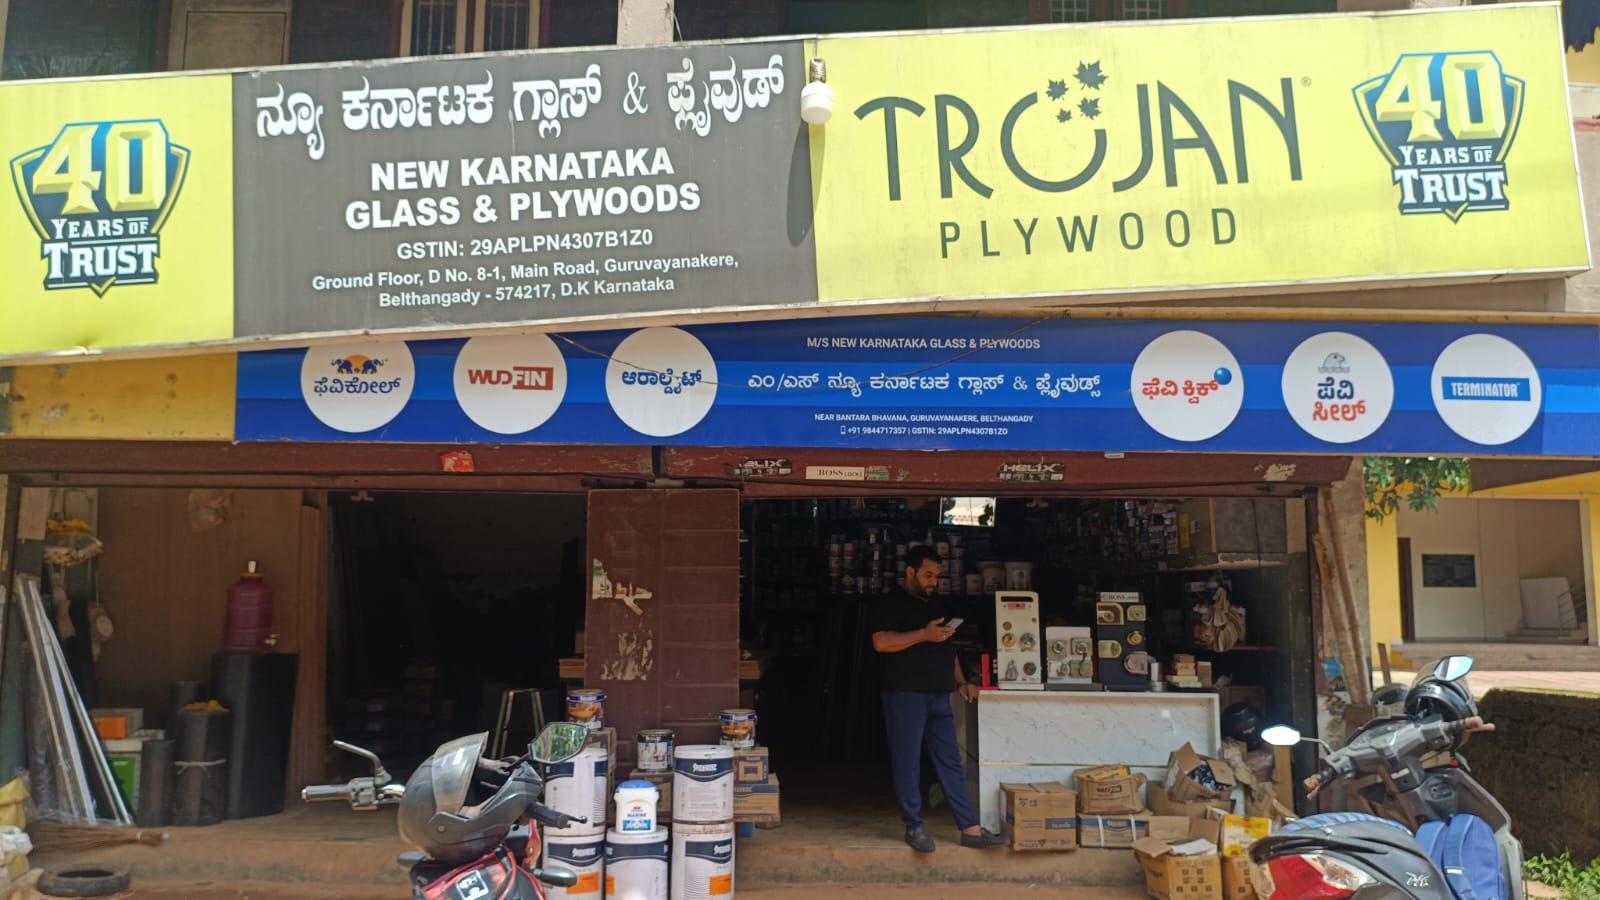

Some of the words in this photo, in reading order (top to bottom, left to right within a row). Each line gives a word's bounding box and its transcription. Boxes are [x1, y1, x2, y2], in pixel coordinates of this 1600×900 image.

[256, 81, 325, 160] ನ್ಯೂ
[342, 68, 494, 130] ಕರ್ನಾಟಕ
[512, 63, 602, 139] ಗ್ಲಾಸ್
[623, 71, 648, 115] &
[1375, 54, 1506, 142] 40
[853, 77, 1302, 201] TROJAN
[32, 121, 167, 215] 40
[370, 160, 449, 191] NEW
[460, 147, 675, 187] KARNATAKA
[1398, 146, 1469, 165] YEARS
[1471, 146, 1492, 162] OF
[1394, 169, 1504, 203] TRUST
[345, 196, 461, 230] GLASS
[472, 194, 498, 223] &
[510, 182, 701, 221] PLYWOODS
[51, 218, 123, 240] YEARS
[127, 216, 149, 235] OF
[939, 208, 1237, 259] PLYWOOD
[43, 241, 158, 279] TRUST
[397, 240, 464, 260] GSTIN:
[312, 273, 373, 290] Ground
[378, 271, 423, 287] Floor,
[429, 269, 441, 284] D
[446, 268, 472, 283] No.
[477, 266, 506, 282] 8-1,
[511, 264, 549, 279] Main
[553, 259, 599, 276] Road,
[604, 253, 739, 273] Guruvayanakere,
[379, 288, 481, 308] Belthangady
[495, 283, 556, 301] 574217,
[560, 281, 590, 297] D.K
[594, 277, 675, 294] Karnataka
[807, 337, 829, 348] M/S
[831, 337, 857, 348] NEW
[859, 337, 927, 349] KARNATAKA
[929, 338, 967, 349] GLASS
[968, 339, 977, 349] &
[979, 338, 1041, 349] PLYWOODS
[314, 376, 402, 397] ಫೆವಿಕೋಲ್
[468, 367, 553, 390] WUDFIN
[748, 373, 819, 391] ಎಂ/ಎಸ್
[827, 372, 862, 398] ನ್ಯೂ
[869, 372, 950, 389] ಕರ್ನಾಟಕ
[958, 374, 1004, 395] ಗ್ಲಾಸ್
[1013, 376, 1028, 390] &
[1451, 382, 1518, 397] TERMINATOR
[871, 414, 909, 422] BHAVANA,
[1312, 400, 1366, 421] ಸೀಲ್
